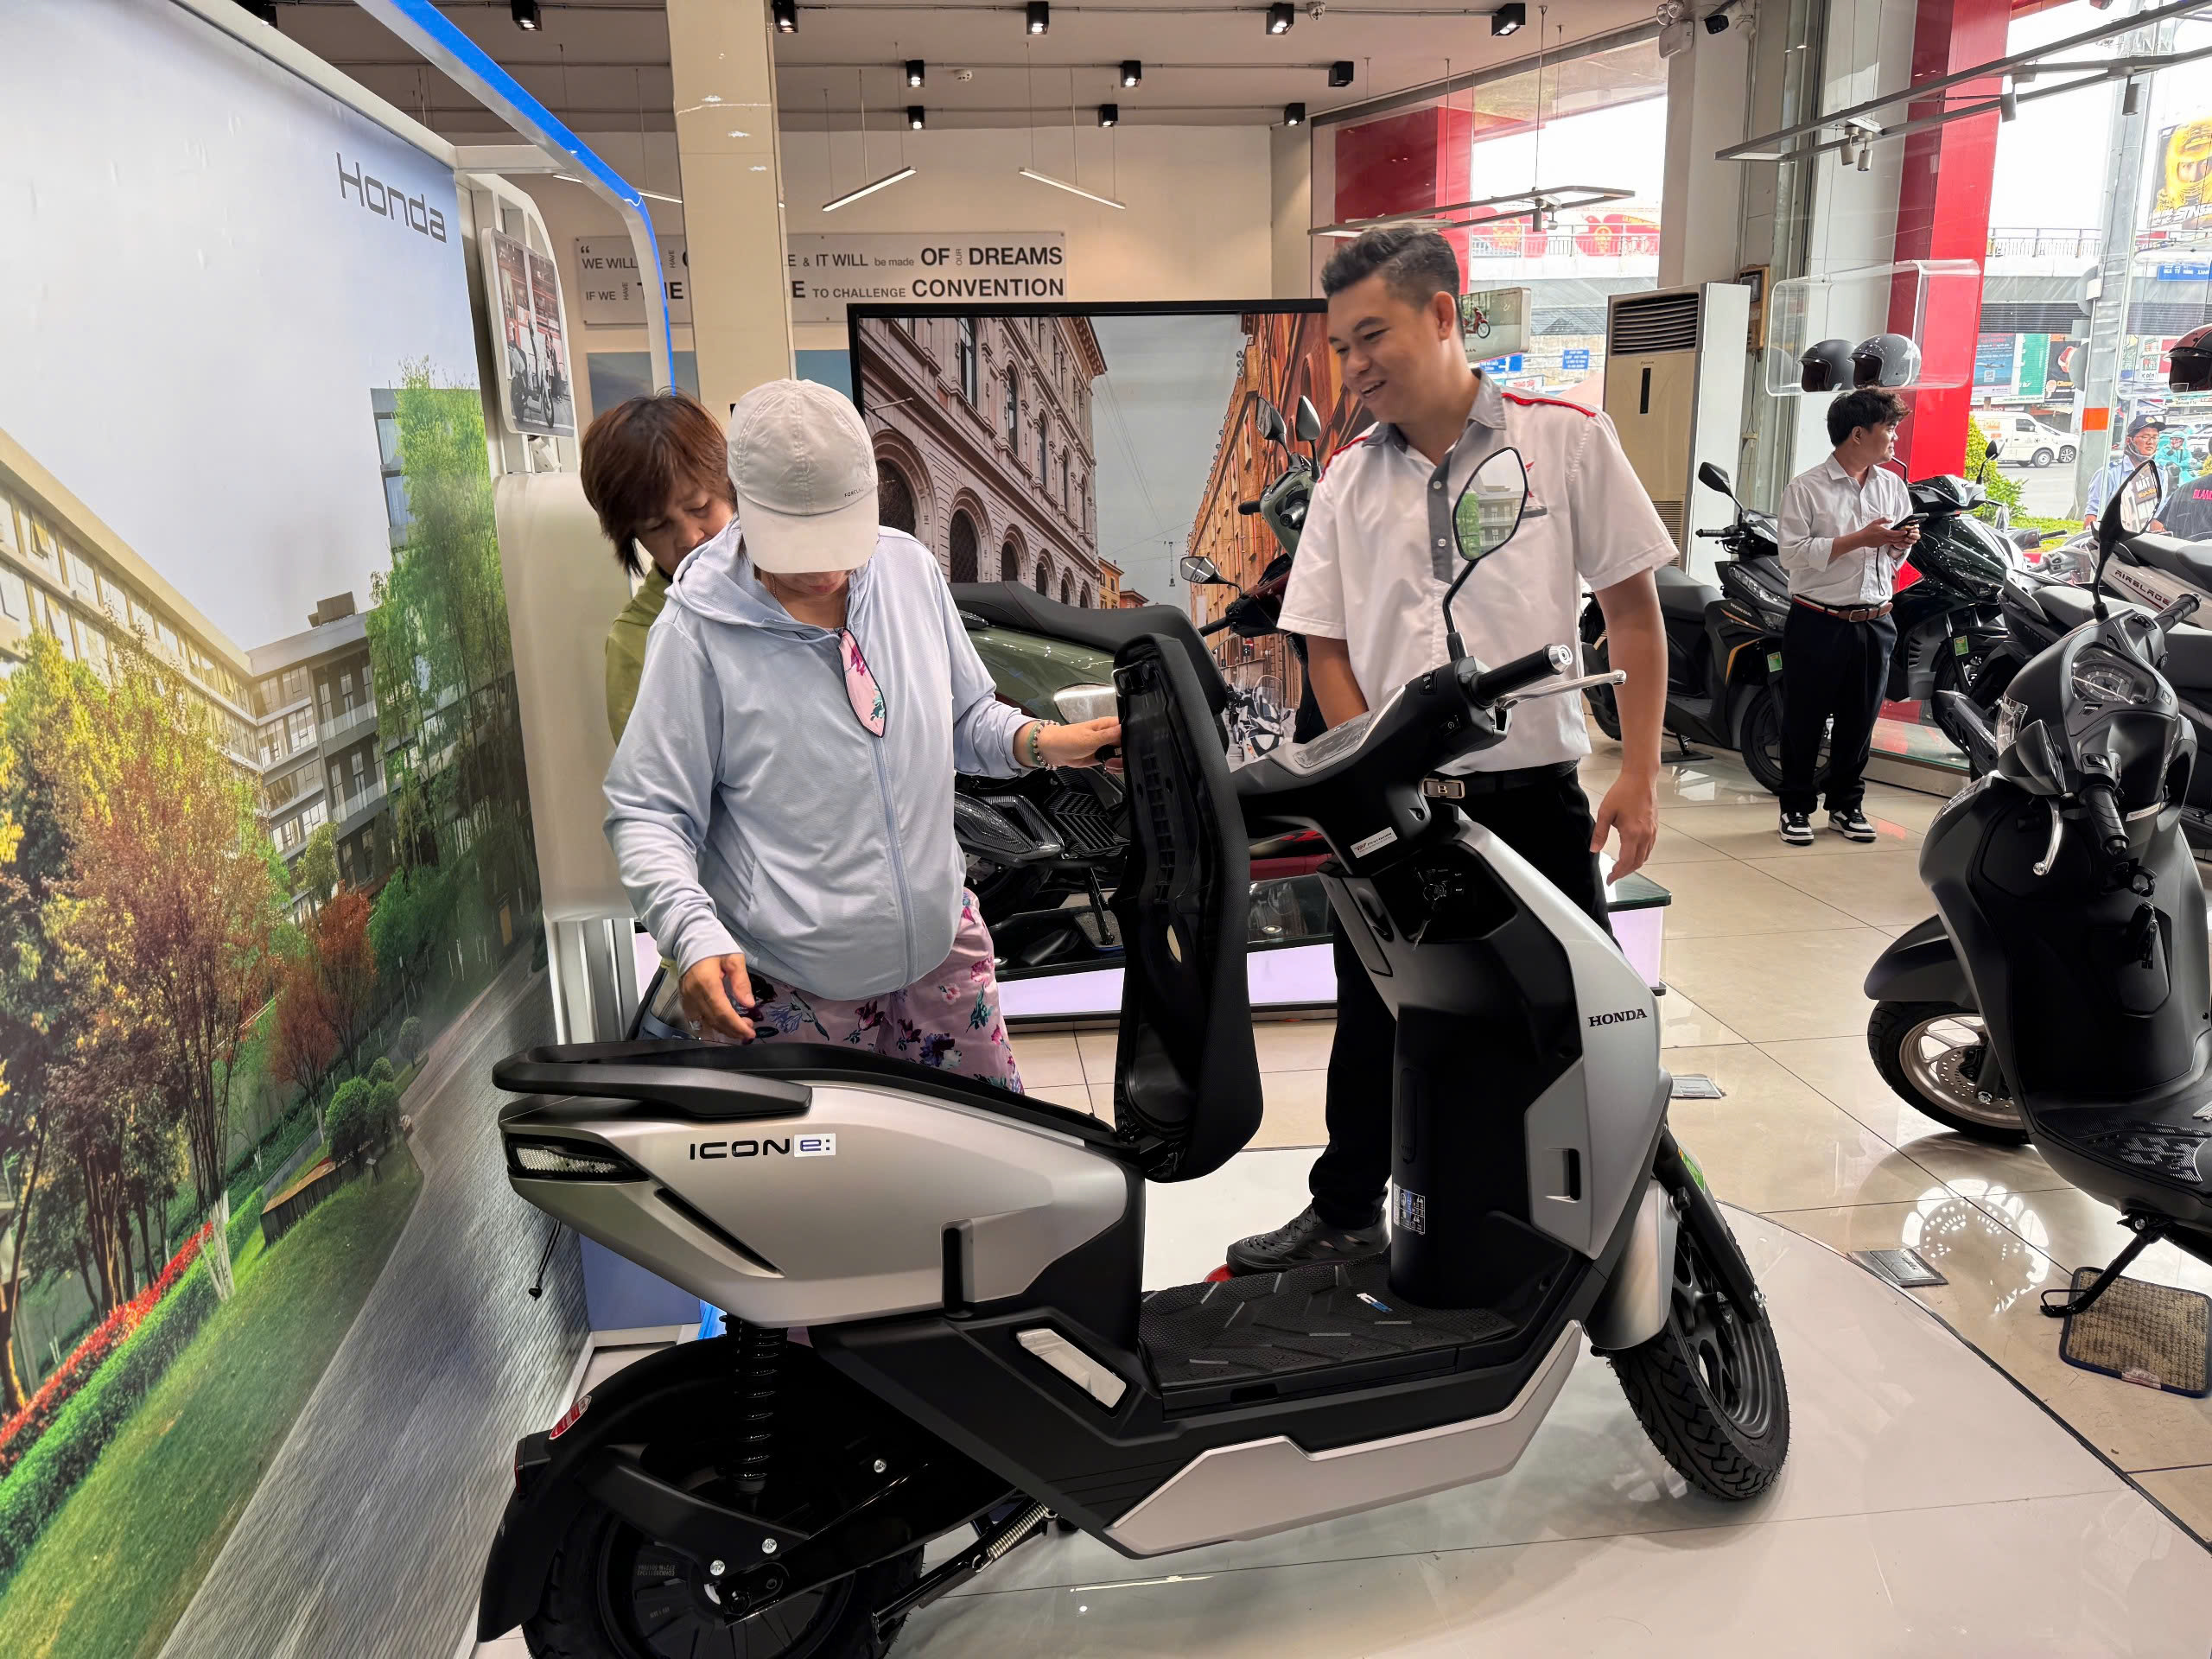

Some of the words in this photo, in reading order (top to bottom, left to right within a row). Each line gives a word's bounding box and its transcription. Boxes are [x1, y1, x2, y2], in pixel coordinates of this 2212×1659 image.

[336, 152, 447, 243] Honda
[582, 258, 603, 269] WE
[606, 258, 638, 269] WILL
[803, 257, 810, 267] &
[816, 254, 828, 266] IT
[832, 253, 868, 266] WILL
[874, 257, 886, 266] be
[888, 257, 914, 266] made
[920, 247, 950, 266] OF
[969, 246, 1063, 265] DREAMS
[586, 291, 594, 301] IF
[598, 291, 615, 301] WE
[812, 289, 829, 298] TO
[833, 288, 906, 298] CHALLENGE
[912, 278, 1064, 297] CONVENTION
[2114, 569, 2171, 606] AIRBLADE
[1730, 602, 1752, 618] HONDA
[1437, 785, 1447, 794] B
[1588, 1008, 1648, 1027] HONDA
[690, 1138, 790, 1160] ICON
